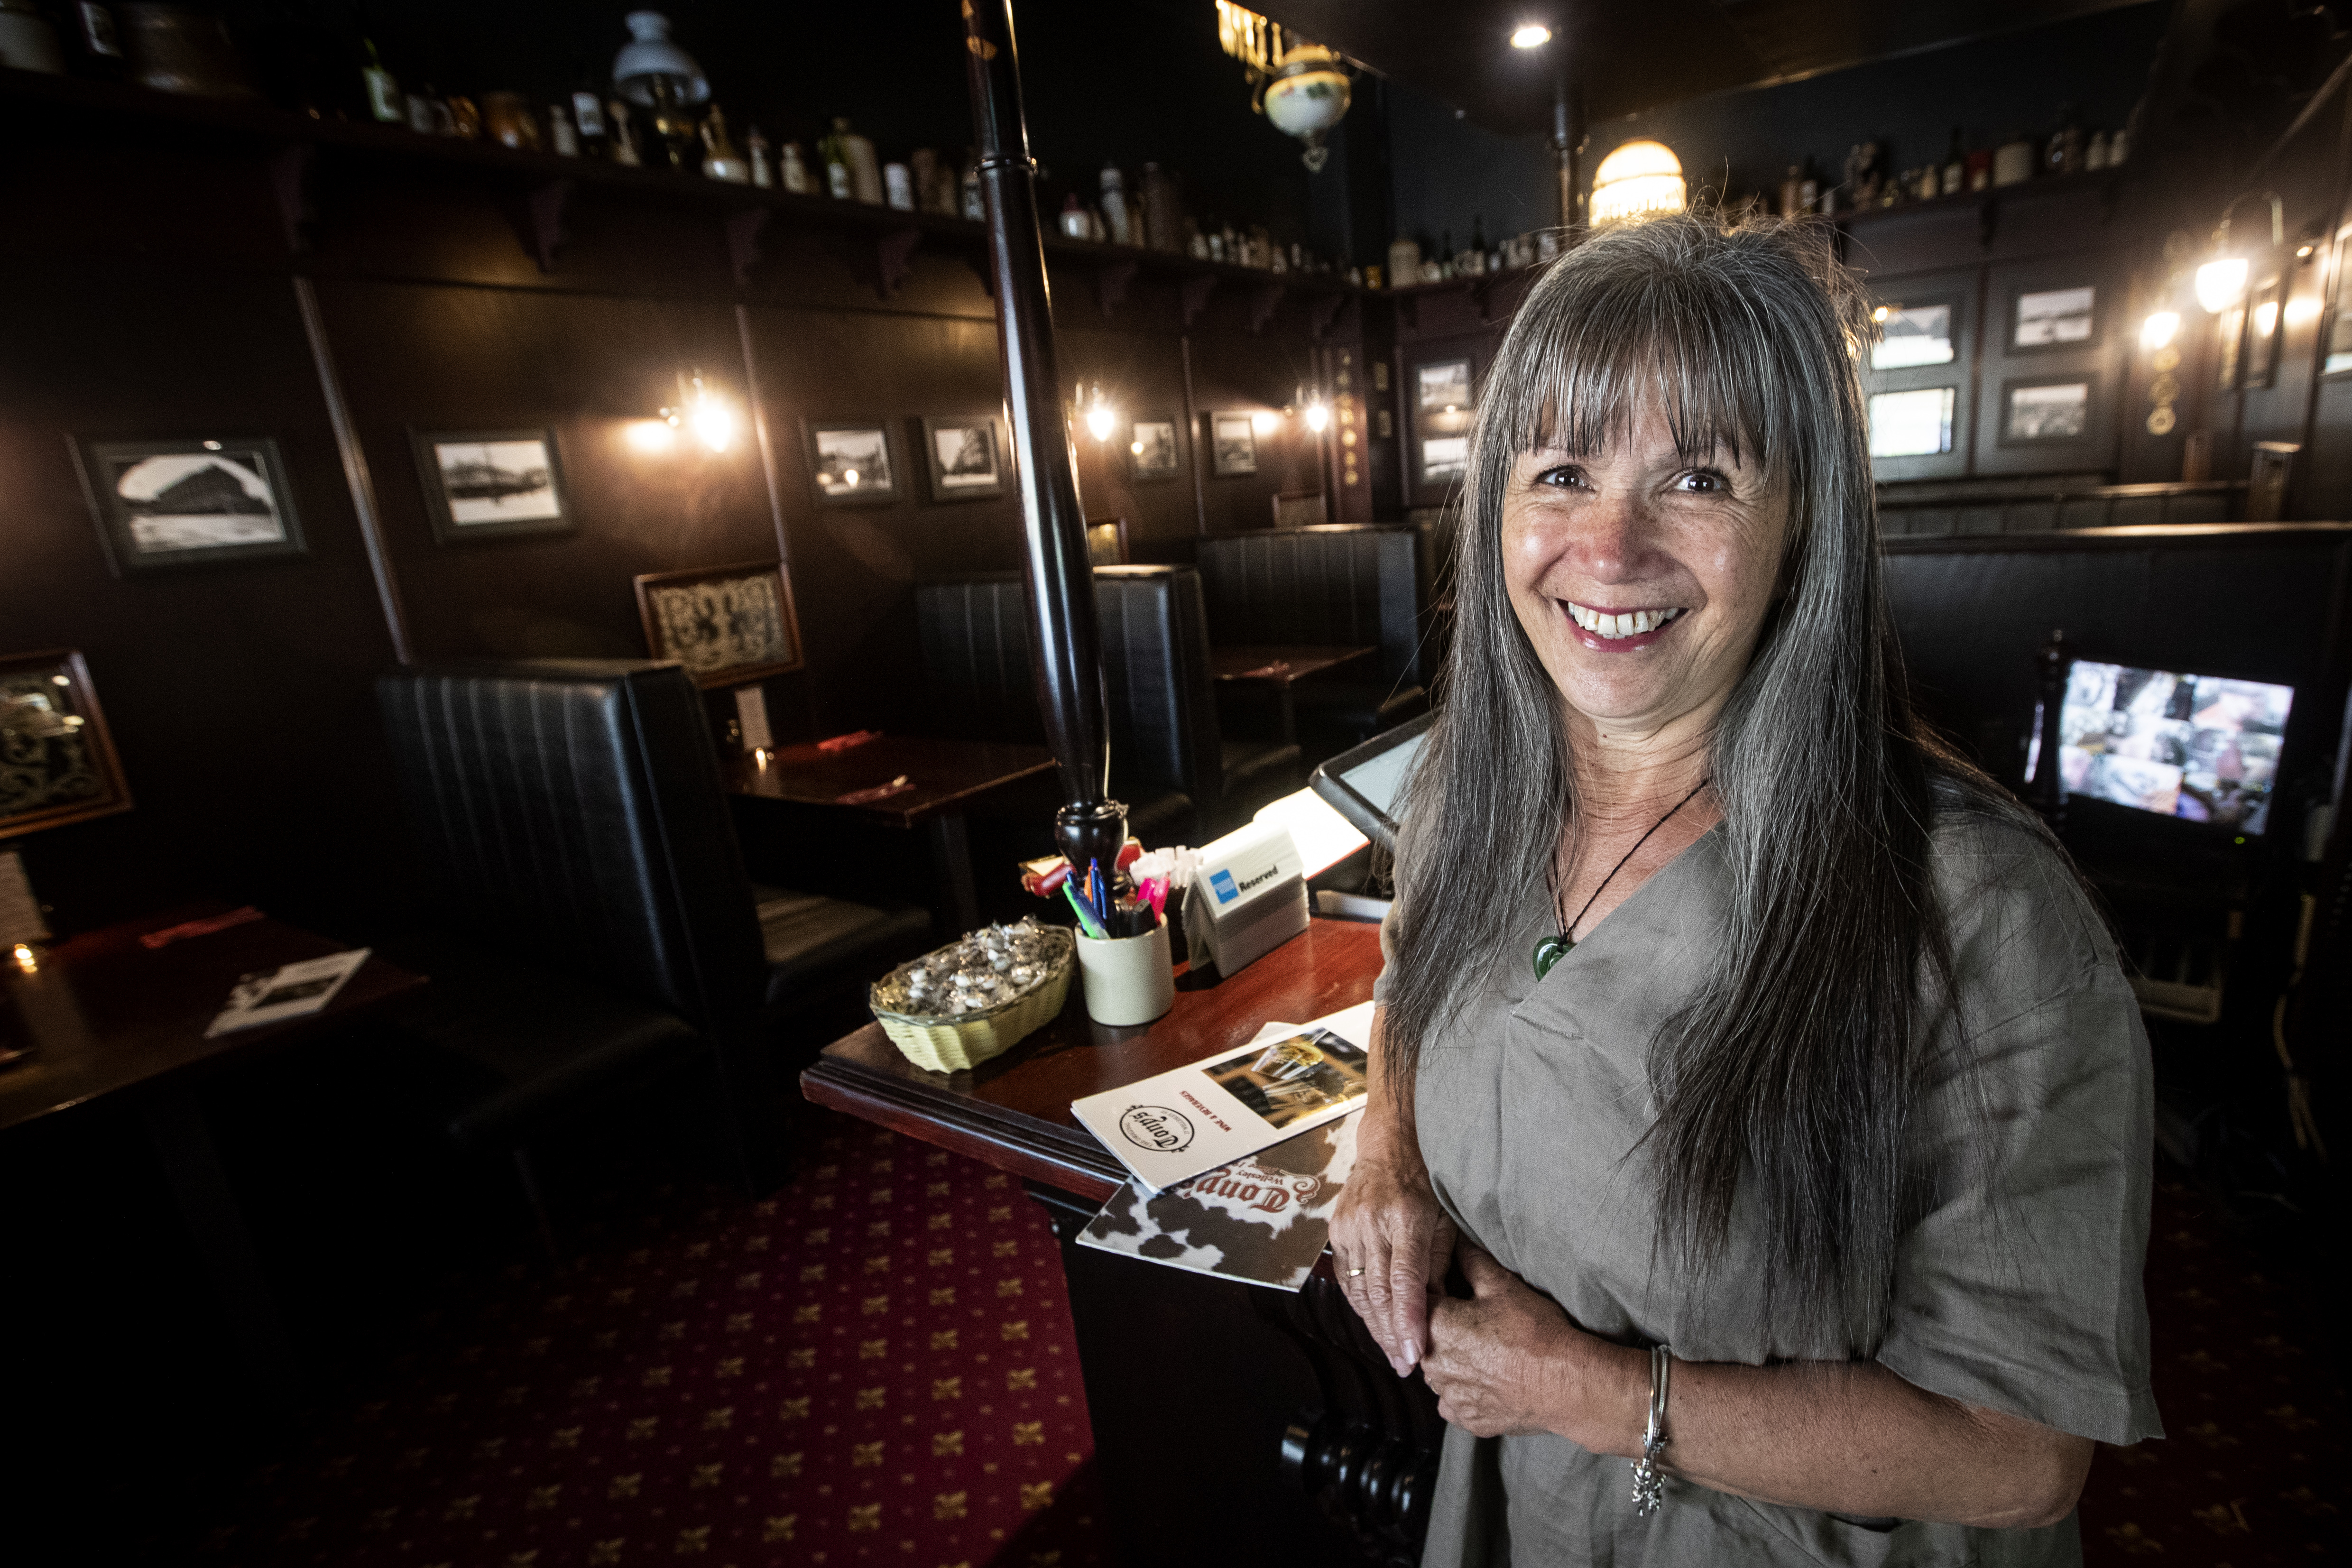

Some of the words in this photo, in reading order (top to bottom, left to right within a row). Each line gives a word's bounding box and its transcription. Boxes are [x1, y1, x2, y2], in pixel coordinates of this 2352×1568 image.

[1239, 865, 1278, 892] Reserved
[1179, 1090, 1212, 1116] BEVERAGES
[1130, 1112, 1179, 1148] Tony's
[1214, 1119, 1232, 1132] WINE
[1236, 1170, 1283, 1185] Wellesley
